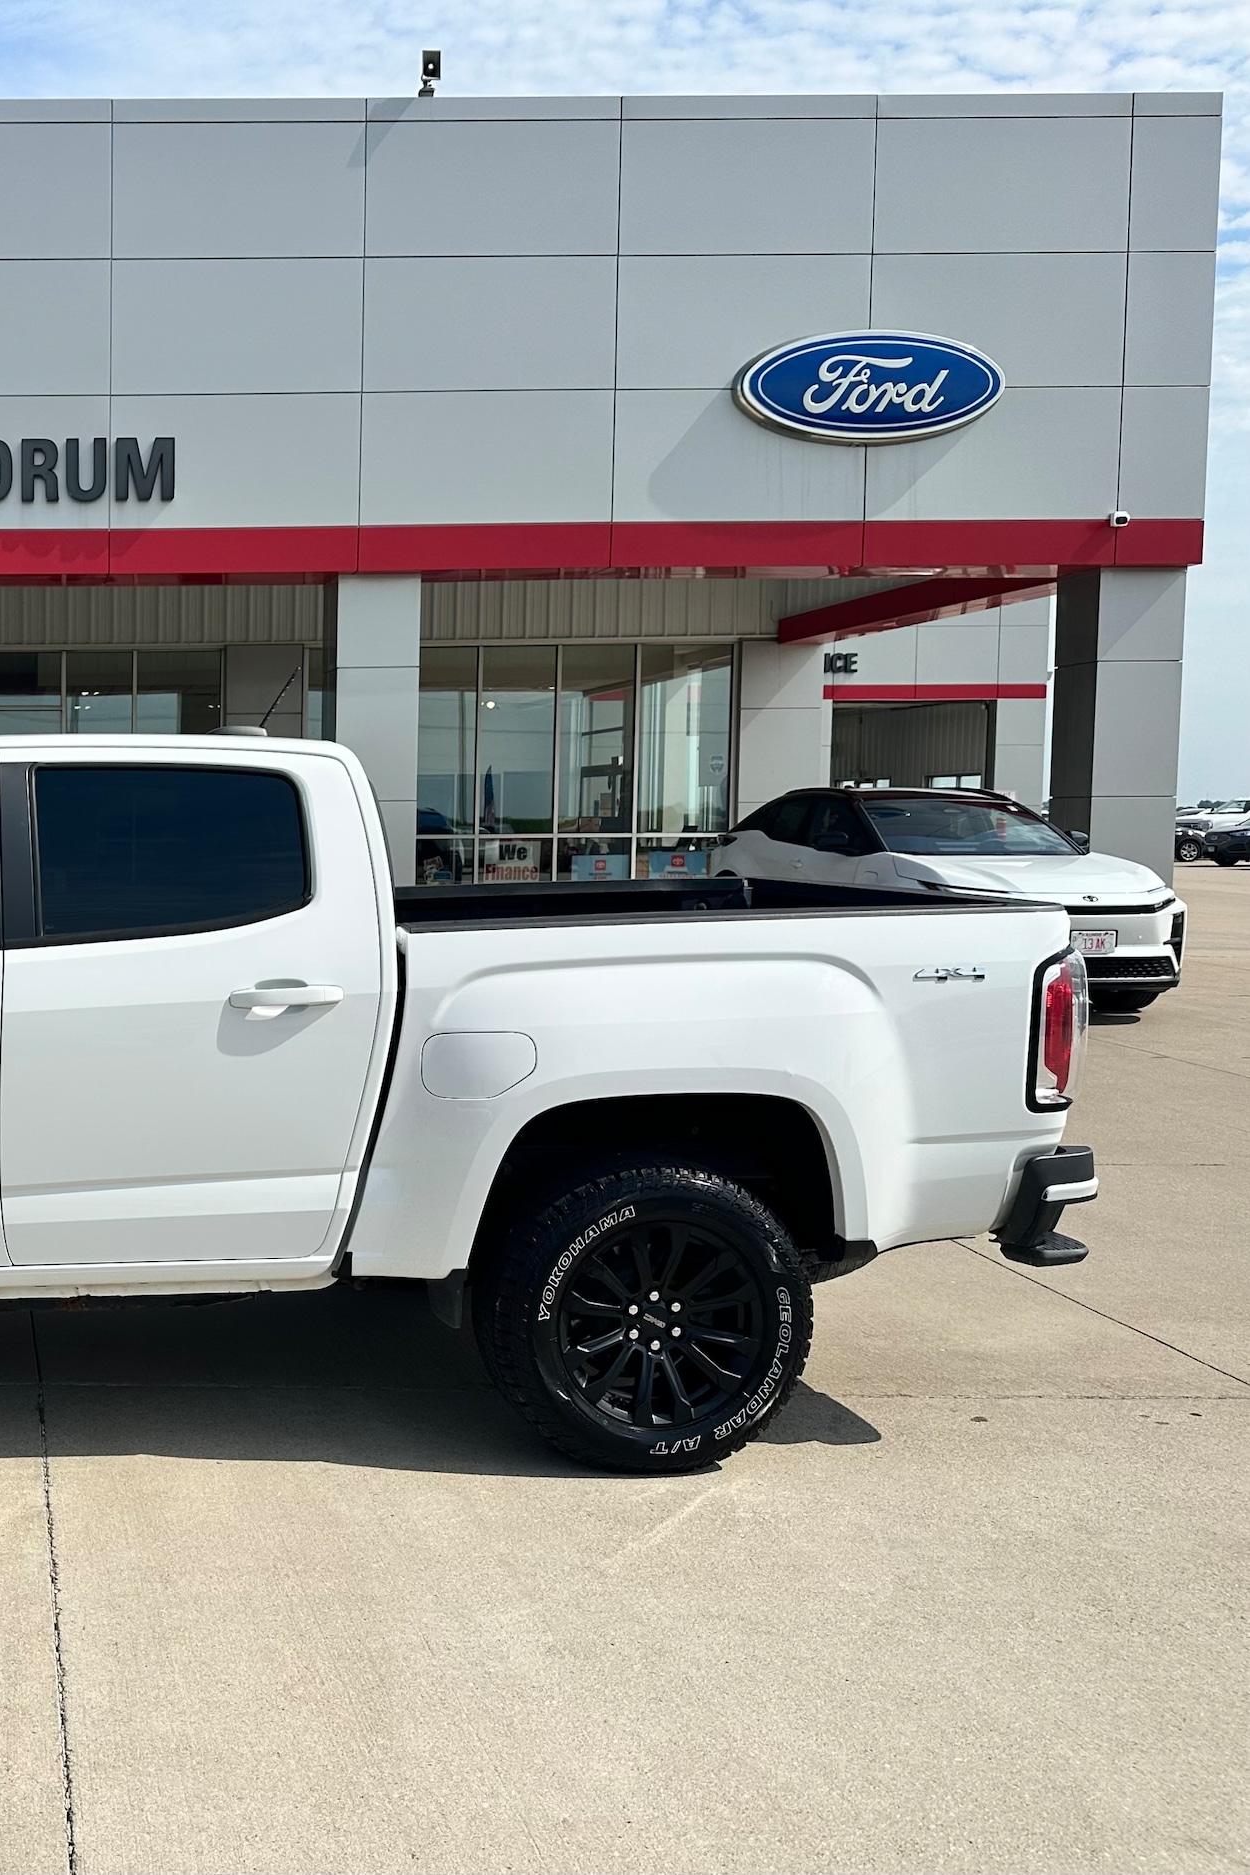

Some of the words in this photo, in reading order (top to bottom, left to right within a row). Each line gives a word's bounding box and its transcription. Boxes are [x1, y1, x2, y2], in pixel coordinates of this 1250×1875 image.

[803, 354, 949, 414] Ford
[824, 653, 858, 674] ICE
[499, 844, 528, 861] We
[485, 864, 538, 881] Finance
[538, 1205, 636, 1321] YOKOHAMA
[713, 1286, 793, 1439] GEOLANDAR
[650, 1435, 701, 1454] A/T
